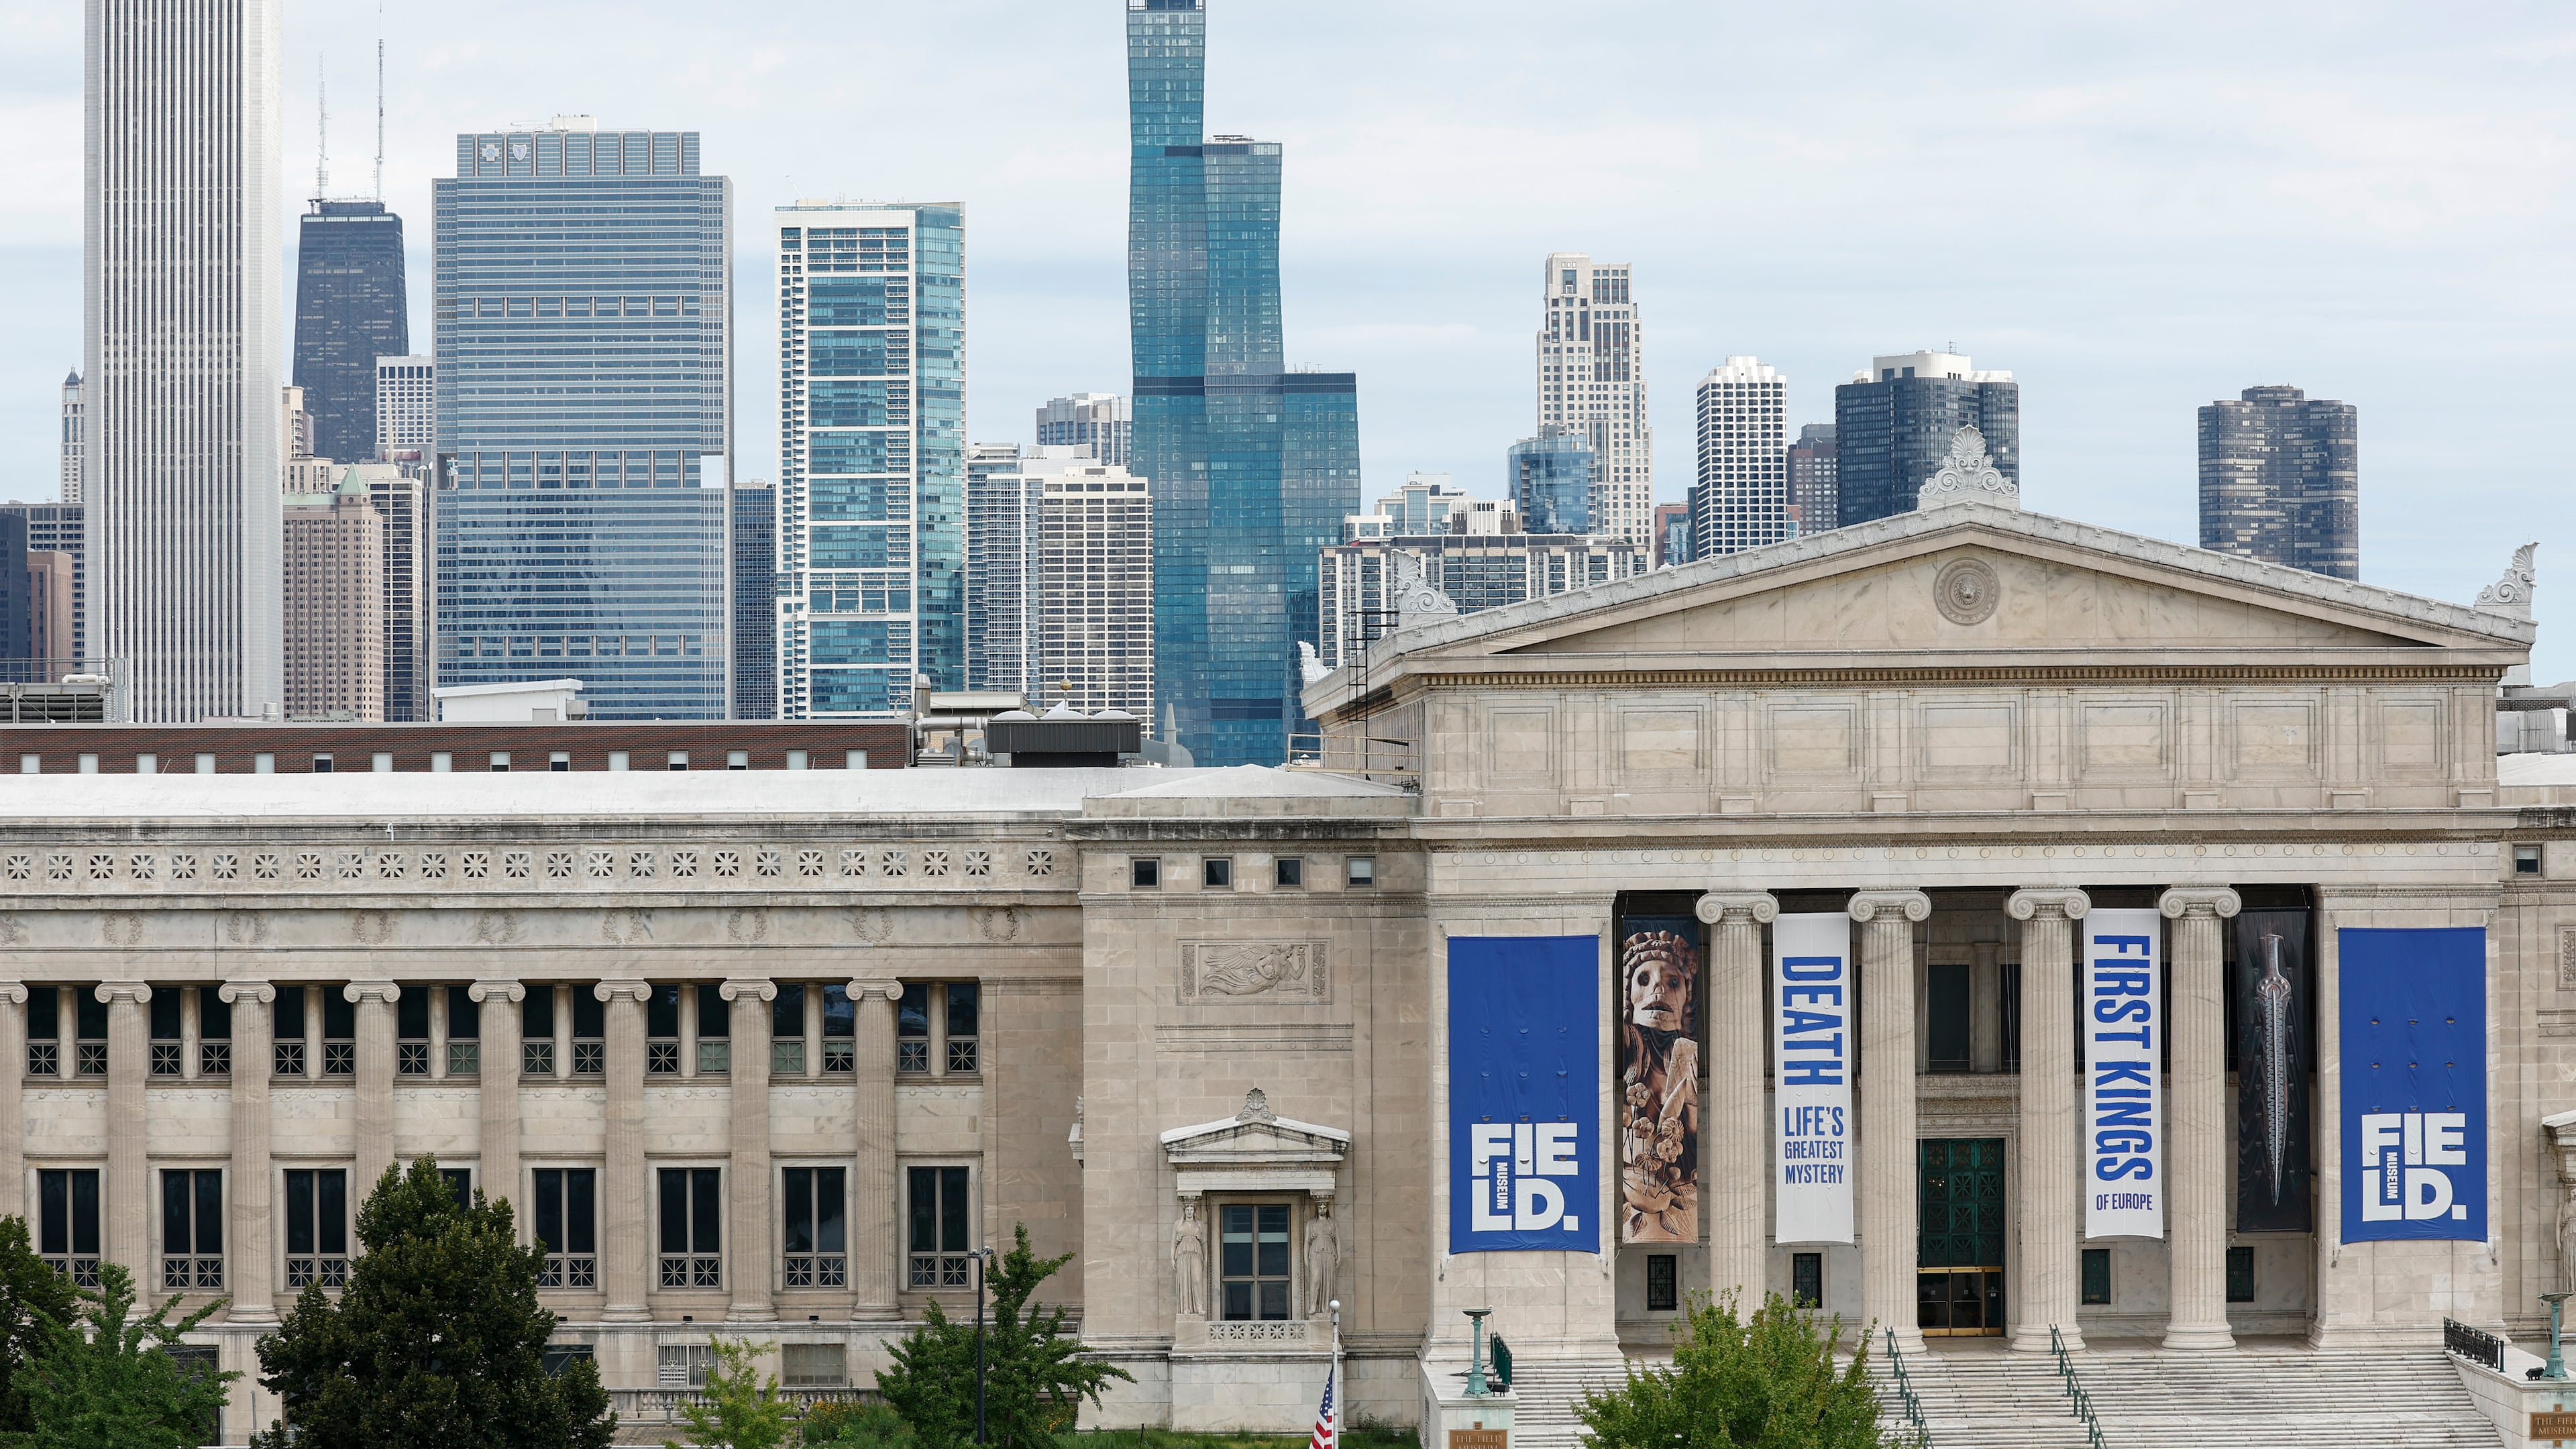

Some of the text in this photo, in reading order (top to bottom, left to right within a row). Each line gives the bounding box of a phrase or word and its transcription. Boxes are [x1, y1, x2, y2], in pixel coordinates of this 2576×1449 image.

[1782, 956, 1843, 1085] DEATH
[2094, 935, 2153, 1181] FIRST KINGS
[1784, 1106, 1843, 1136] LIFE'S
[1784, 1140, 1844, 1160] GREATEST
[1785, 1164, 1844, 1184] MYSTERY
[2386, 1152, 2398, 1199] MUSEUM
[1497, 1162, 1509, 1210] MUSEUM
[2096, 1193, 2153, 1211] OF EUROPE
[2536, 1417, 2576, 1426] THE FIEL
[2538, 1427, 2576, 1435] MUSEUM
[1455, 1435, 1503, 1443] THE FIELD
